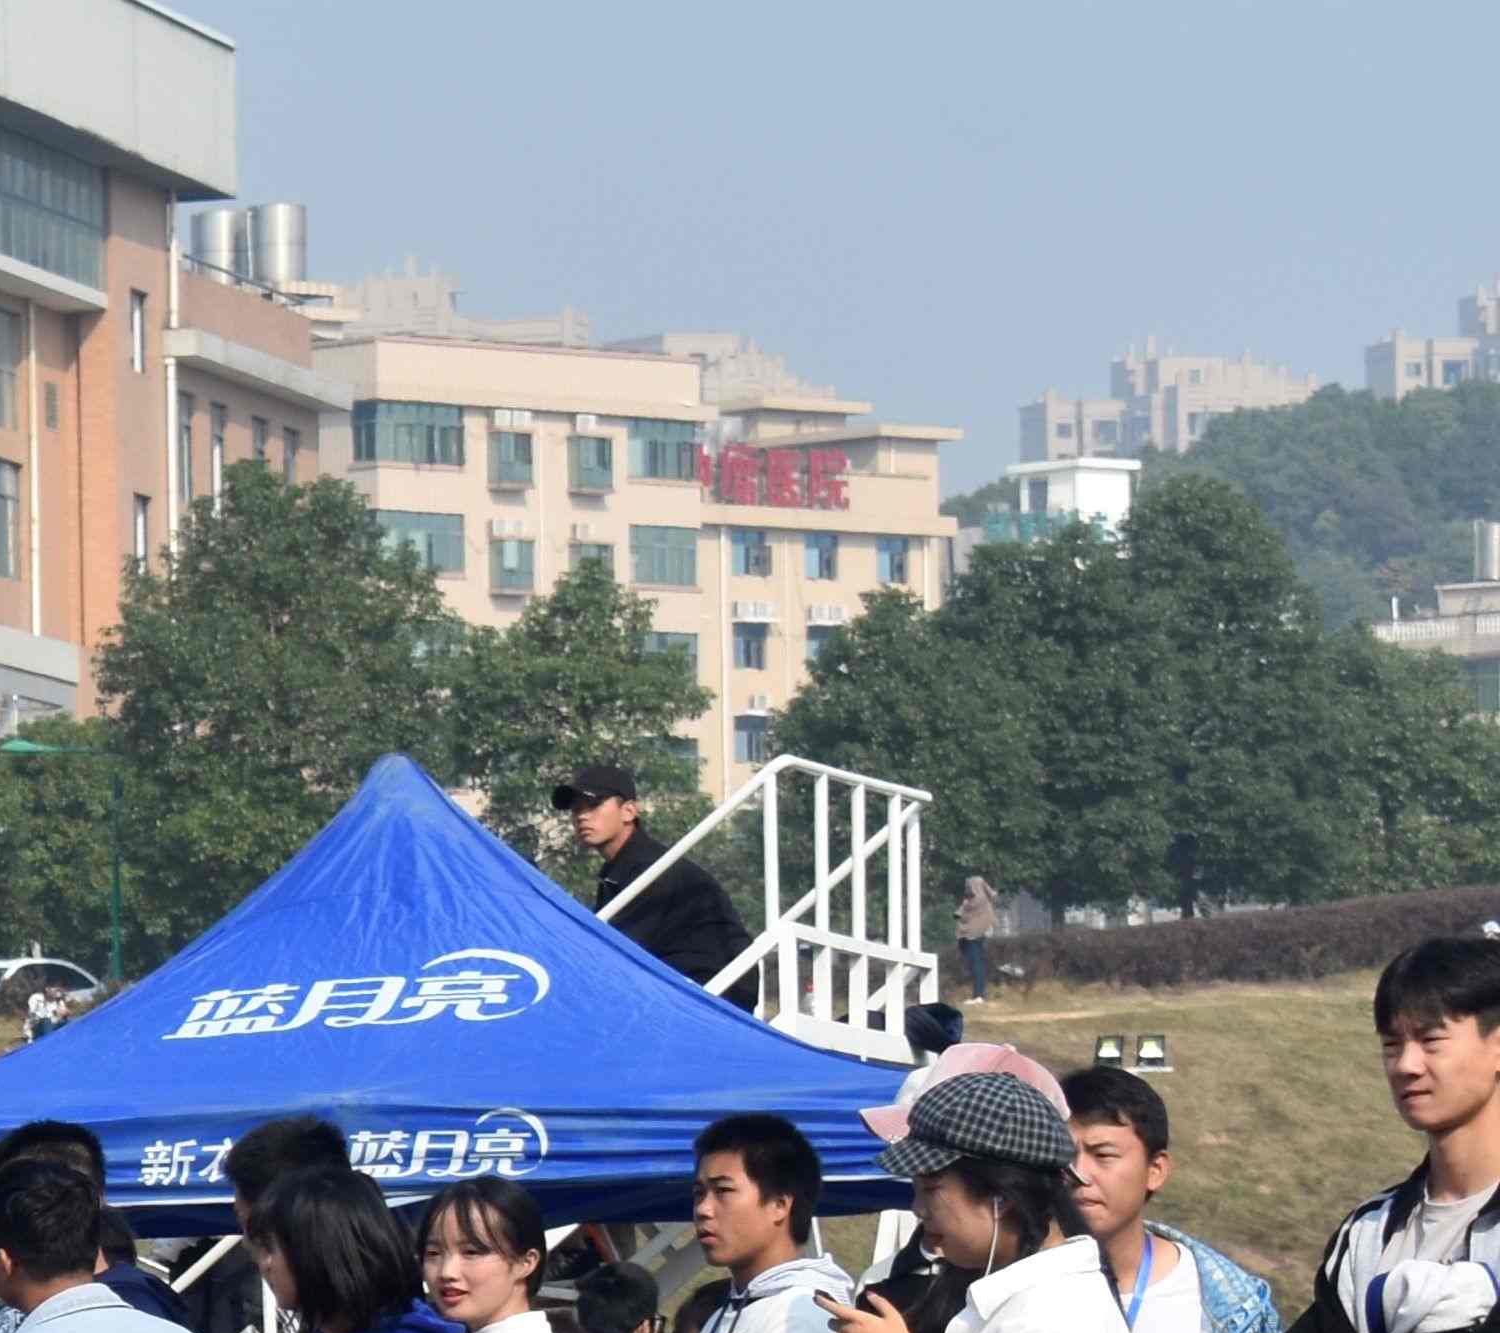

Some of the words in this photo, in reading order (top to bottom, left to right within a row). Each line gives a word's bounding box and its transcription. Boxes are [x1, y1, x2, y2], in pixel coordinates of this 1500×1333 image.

[161, 948, 551, 1041] 蓝月亮
[349, 1107, 548, 1179] 蓝月亮
